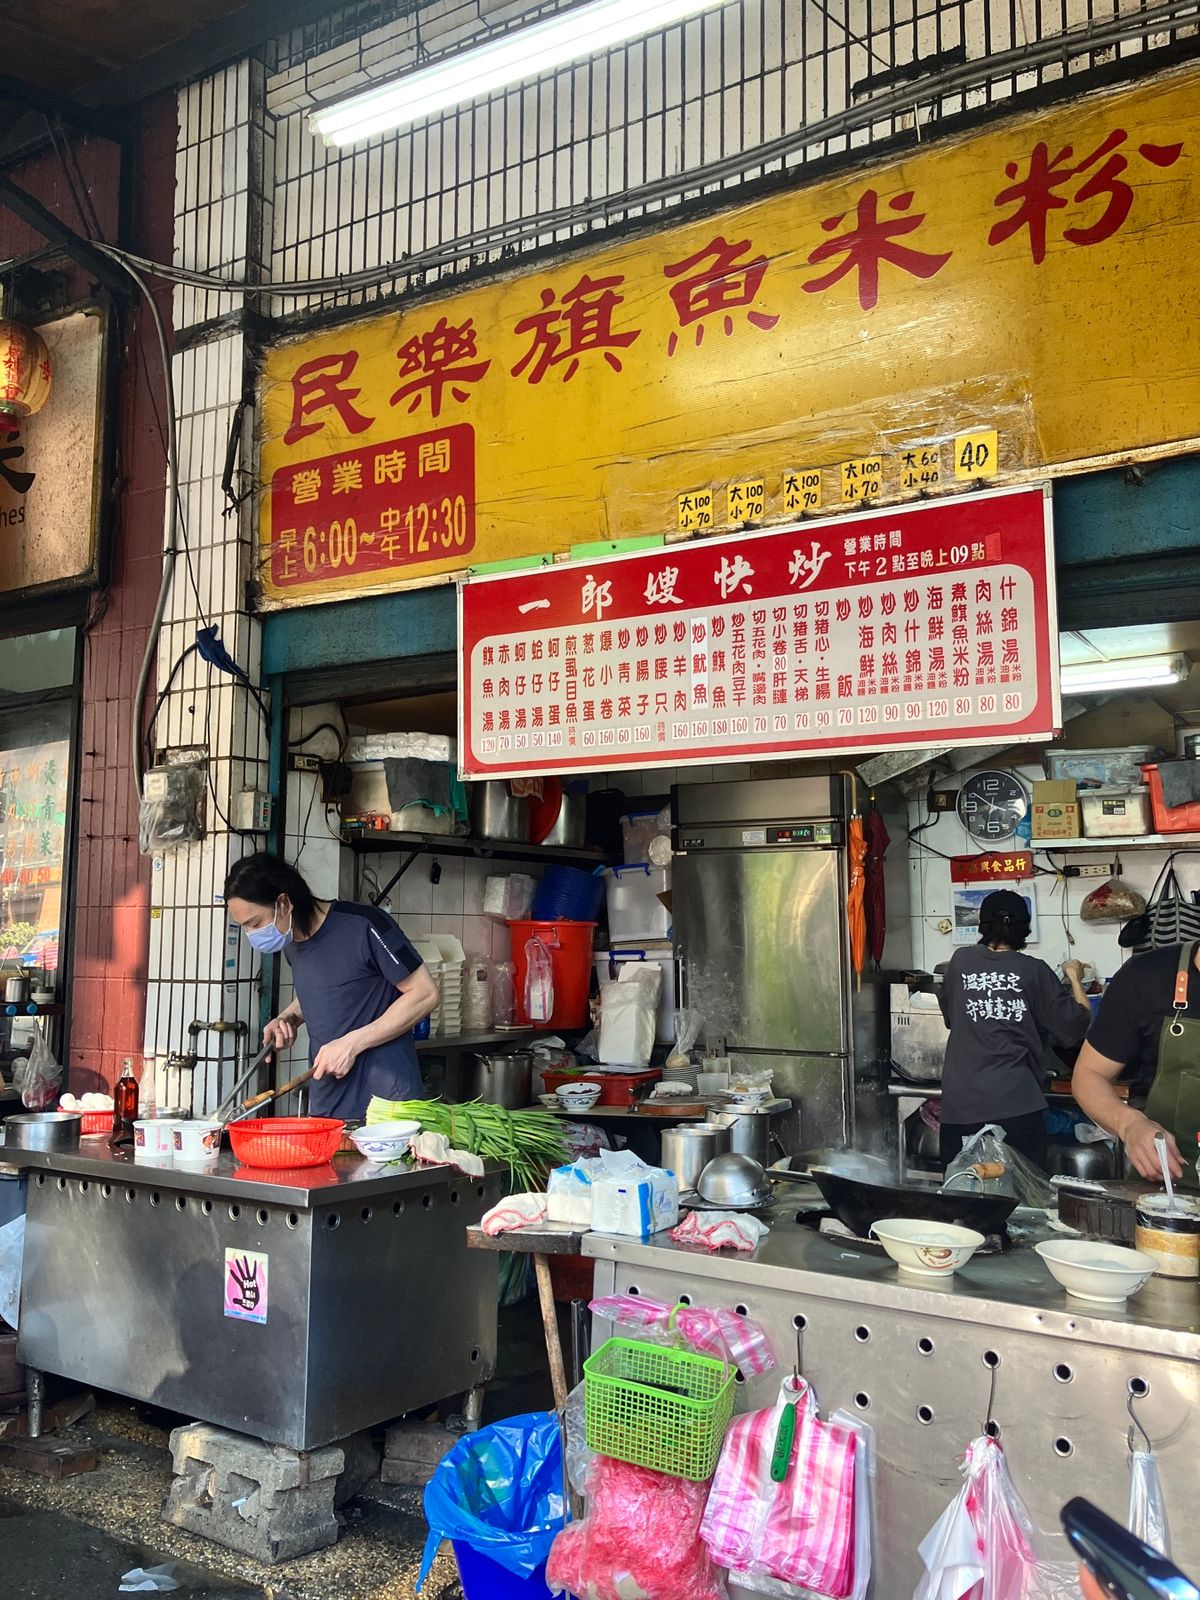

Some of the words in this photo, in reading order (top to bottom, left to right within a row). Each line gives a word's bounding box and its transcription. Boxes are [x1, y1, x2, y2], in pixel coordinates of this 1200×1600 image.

[283, 128, 1184, 446] 民樂旗魚米粉
[959, 441, 989, 471] 40
[292, 438, 451, 505] 營業時間
[844, 530, 902, 556] 營業時間
[518, 541, 832, 620] 一郎嫂快炒
[975, 579, 994, 667] 肉絲湯
[1000, 575, 1019, 664] 什錦湯
[881, 592, 898, 676] 炒肉絲
[904, 589, 921, 673] 炒什錦
[927, 586, 945, 671] 海鮮湯
[858, 596, 875, 678] 炒海鮮
[836, 599, 853, 698] 炒飯
[636, 626, 649, 716] 炒腸子
[673, 621, 687, 712] 炒羊肉
[692, 623, 707, 705] 炒魷魚
[618, 628, 631, 717] 炒青菜
[498, 644, 510, 731] 赤肉湯
[515, 642, 527, 729] 蚵仔湯
[532, 640, 543, 727] 蛤仔湯
[548, 637, 561, 725] 蚵仔蛋
[929, 700, 947, 716] 120
[956, 699, 970, 714] 80
[980, 697, 994, 712] 80
[1005, 695, 1019, 709] 80
[839, 709, 852, 724] 70
[859, 707, 877, 723] 120
[885, 705, 899, 721] 90
[907, 703, 920, 718] 90
[732, 718, 747, 733] 160
[754, 717, 767, 731] 70
[775, 715, 787, 730] 70
[796, 713, 809, 728] 70
[817, 711, 830, 726] 90
[635, 727, 650, 741] 160
[673, 724, 688, 738] 160
[692, 722, 707, 736] 160
[712, 720, 727, 734] 180
[499, 737, 510, 749] 70
[516, 736, 527, 748] 50
[532, 734, 543, 746] 50
[548, 732, 562, 745] 140
[584, 732, 595, 745] 60
[599, 730, 613, 744] 160
[618, 729, 630, 742] 60
[482, 740, 495, 751] 120
[983, 779, 1000, 791] 12
[964, 801, 978, 812] 9
[987, 821, 1000, 833] 6
[961, 972, 1023, 993] 溫柔堅定
[965, 996, 1027, 1022] 守護臺灣
